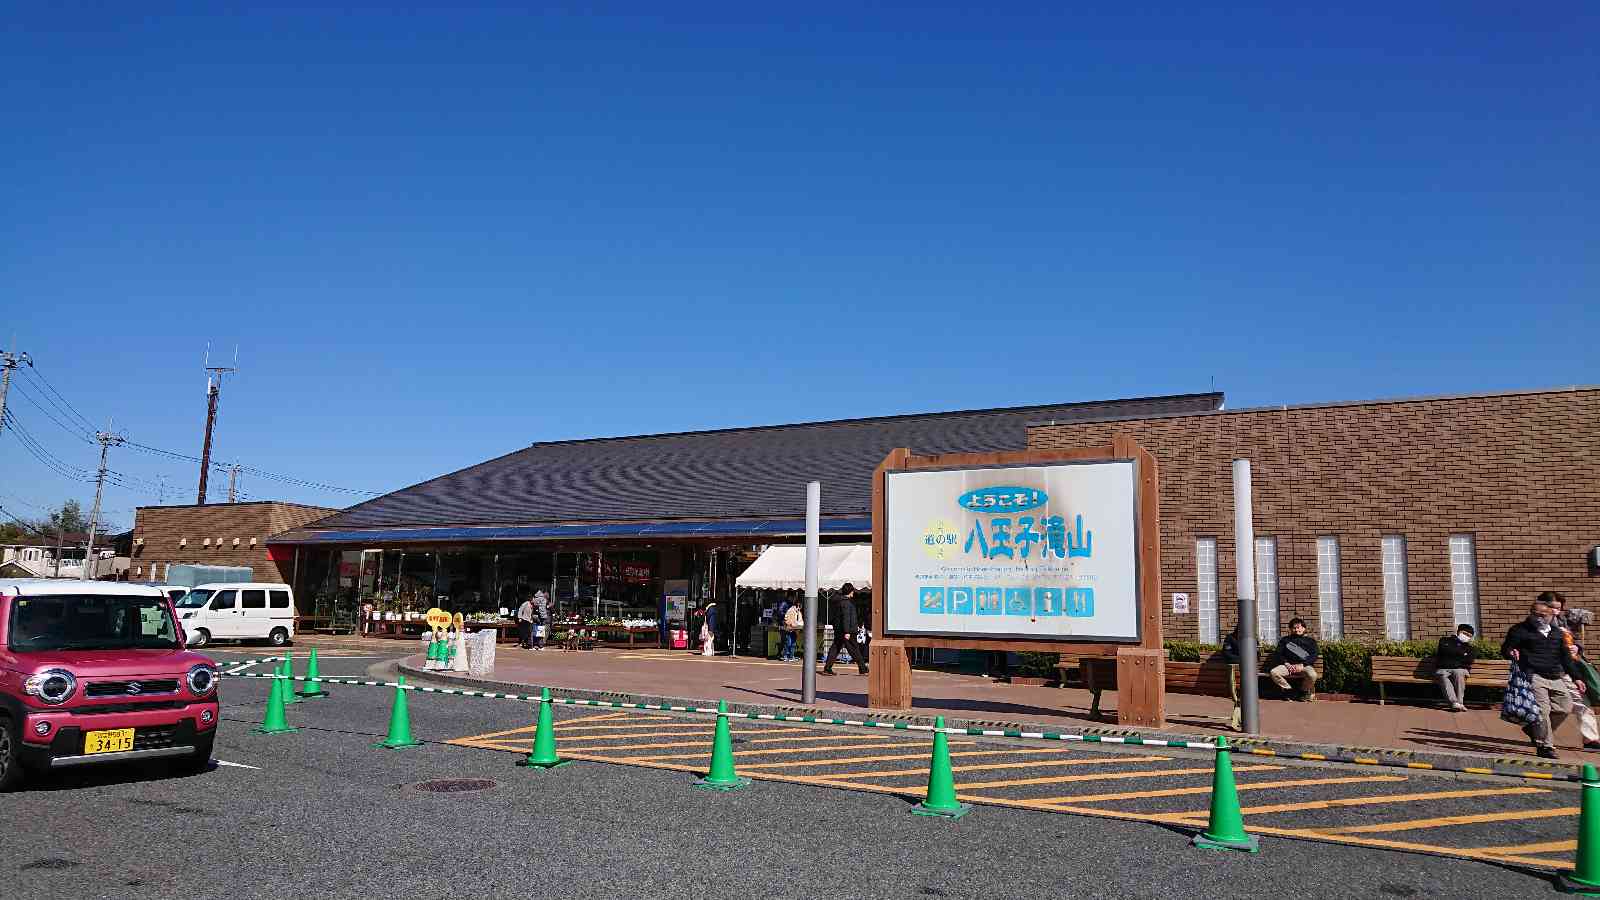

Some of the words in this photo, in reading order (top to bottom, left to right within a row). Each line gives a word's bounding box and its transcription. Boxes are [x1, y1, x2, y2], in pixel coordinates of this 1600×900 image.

[968, 490, 1038, 508] ようこそ!
[924, 534, 957, 546] 道の駅
[964, 515, 1092, 559] 八王子滝山
[952, 591, 969, 610] P
[96, 738, 131, 751] 34-15
